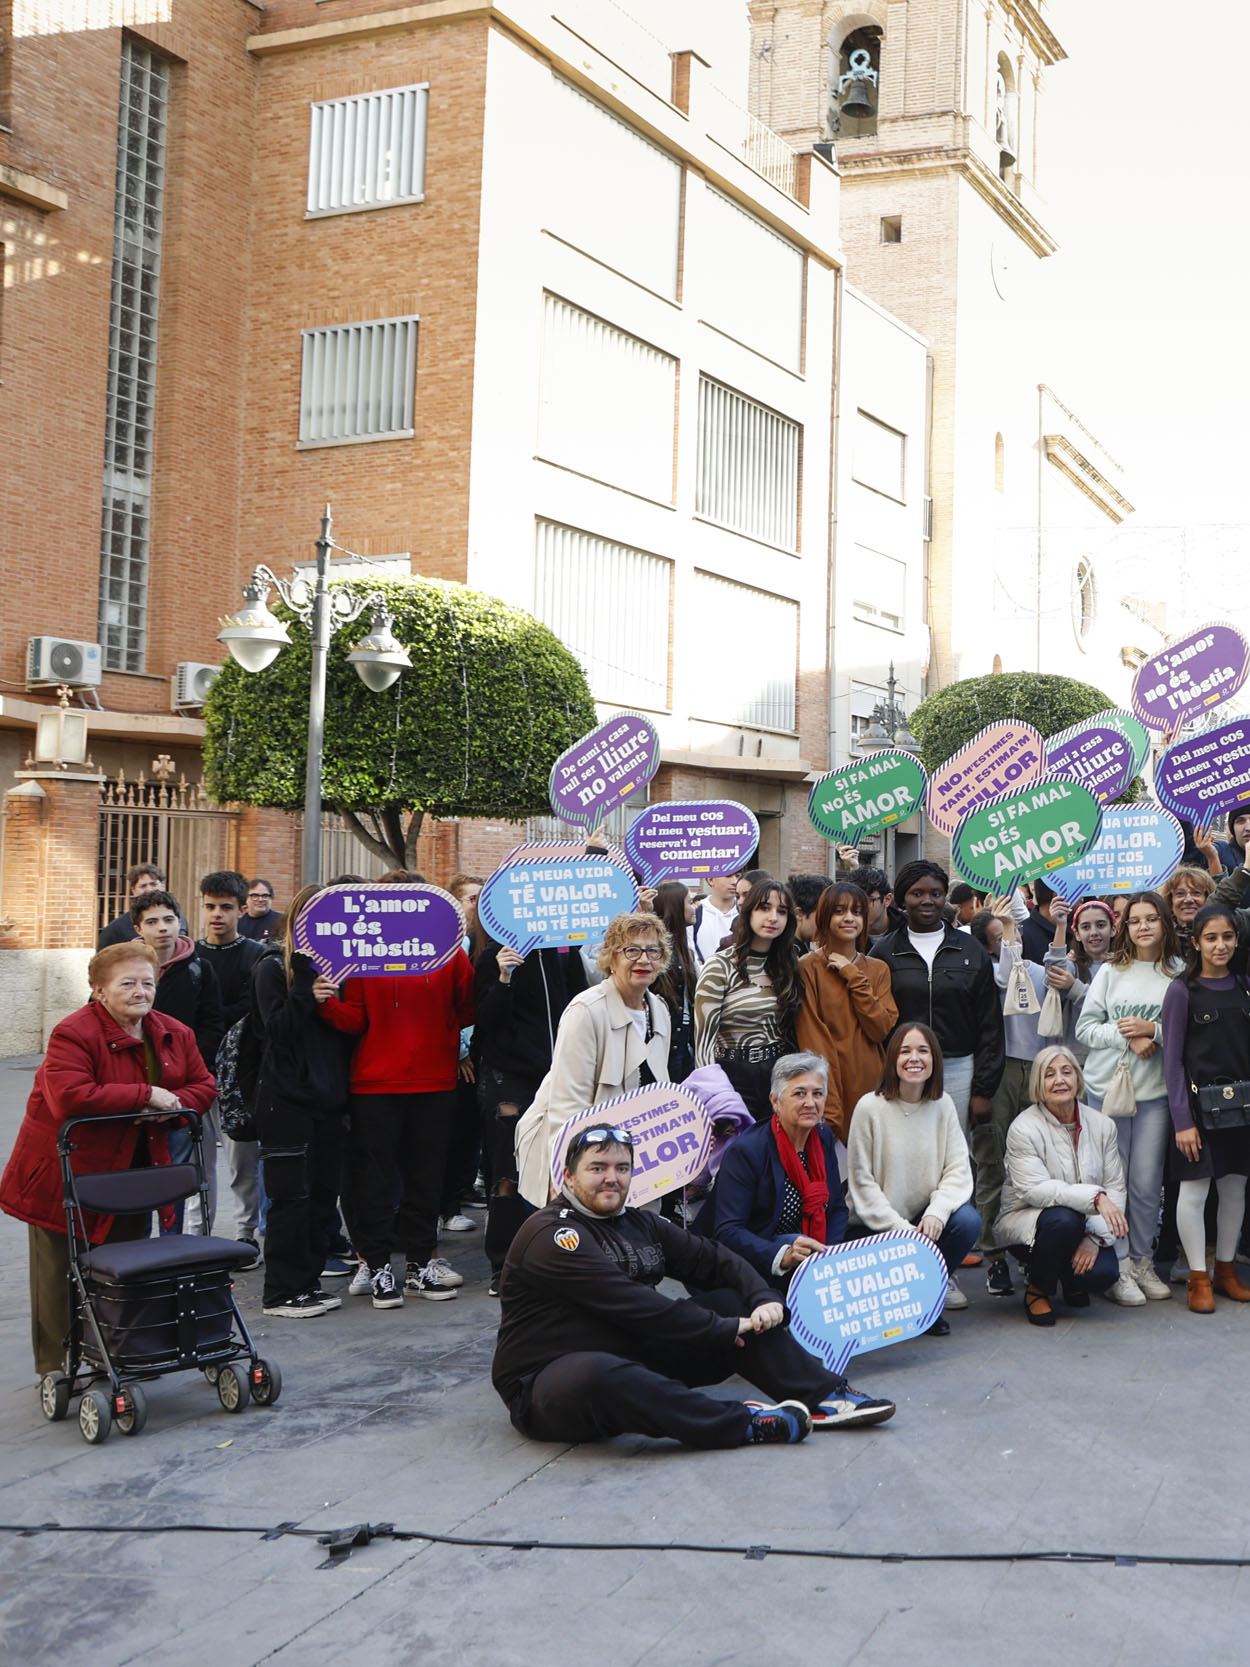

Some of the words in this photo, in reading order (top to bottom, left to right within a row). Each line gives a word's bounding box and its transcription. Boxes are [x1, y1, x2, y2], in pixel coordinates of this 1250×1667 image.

[1154, 634, 1214, 676] L'amor
[1144, 683, 1167, 703] no
[1169, 670, 1191, 688] és
[1167, 666, 1235, 710] l'hòstia
[561, 765, 576, 778] De
[577, 743, 600, 766] camí
[600, 740, 608, 749] a
[608, 724, 630, 742] casa
[1071, 750, 1079, 758] a
[1080, 735, 1103, 752] casa
[1171, 751, 1192, 766] Del
[1192, 742, 1219, 758] meu
[1220, 730, 1244, 745] cos
[560, 776, 581, 796] vull
[580, 765, 596, 780] ser
[597, 730, 649, 773] lliure
[835, 778, 849, 791] SI
[849, 770, 869, 785] FA
[869, 757, 901, 777] MAL
[1166, 774, 1172, 784] i
[1173, 770, 1185, 781] el
[1185, 761, 1211, 777] meu
[578, 778, 606, 806] no
[608, 751, 648, 783] valenta
[937, 773, 962, 796] NO
[1172, 771, 1221, 796] reserva't
[1223, 764, 1235, 776] el
[821, 797, 844, 814] NO
[844, 789, 861, 805] ÉS
[841, 786, 914, 830] AMOR
[940, 784, 976, 813] TANT,
[988, 810, 1006, 827] SI
[1006, 801, 1031, 820] FA
[1031, 784, 1072, 810] MAL
[640, 827, 644, 836] i
[646, 827, 656, 835] el
[658, 827, 683, 835] meu
[687, 823, 752, 836] vestuari,
[652, 814, 670, 822] Del
[672, 814, 697, 822] meu
[700, 812, 724, 821] cos
[1124, 815, 1158, 827] VIDA
[640, 839, 686, 848] reserva't
[691, 838, 701, 846] el
[660, 846, 740, 860] comentari
[970, 836, 998, 857] NO
[998, 826, 1021, 845] ÉS
[994, 821, 1087, 877] AMOR
[1118, 851, 1144, 862] COS
[510, 872, 530, 883] LA
[533, 869, 573, 881] MEUA
[576, 867, 614, 878] VIDA
[1077, 869, 1094, 880] NO
[1098, 865, 1114, 878] TÉ
[1117, 865, 1152, 877] PREU
[343, 894, 430, 912] L'amor
[508, 883, 536, 904] TÉ
[540, 883, 617, 902] VALOR,
[513, 907, 533, 919] EL
[536, 904, 568, 917] MEU
[571, 902, 600, 914] COS
[527, 921, 547, 932] NO
[550, 918, 568, 930] TÉ
[572, 916, 609, 928] PREU
[315, 922, 348, 936] no
[353, 914, 382, 935] és
[342, 937, 436, 957] l'hòstia
[813, 1265, 834, 1281] LA
[836, 1253, 878, 1275] MEUA
[879, 1242, 917, 1263] VIDA
[815, 1278, 844, 1307] TÉ
[846, 1263, 925, 1297] VALOR,
[823, 1308, 844, 1324] EL
[846, 1296, 880, 1317] MEU
[881, 1287, 910, 1306] COS
[840, 1322, 861, 1337] NO
[863, 1311, 882, 1330] TÉ
[884, 1302, 923, 1324] PREU
